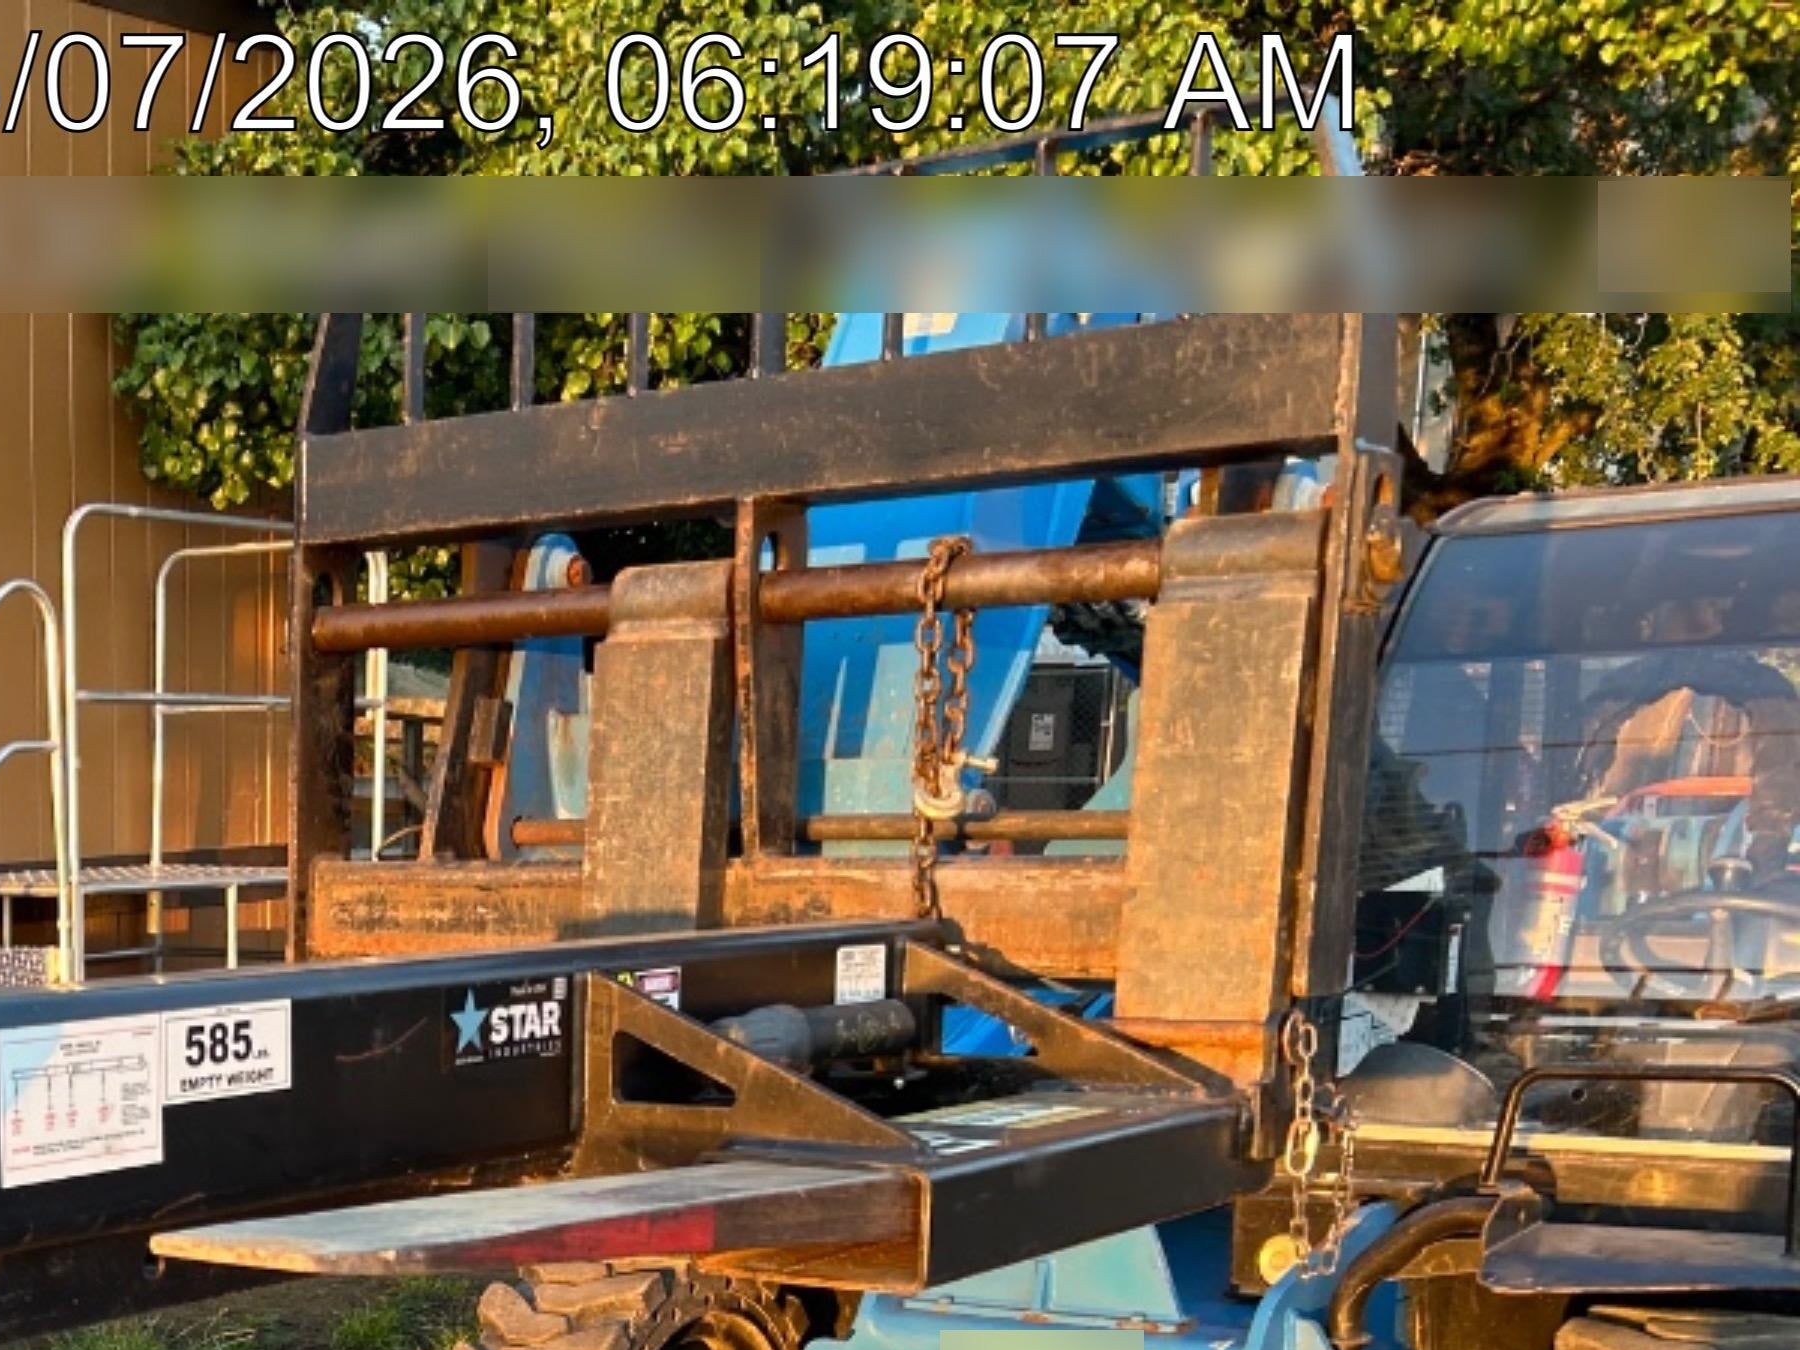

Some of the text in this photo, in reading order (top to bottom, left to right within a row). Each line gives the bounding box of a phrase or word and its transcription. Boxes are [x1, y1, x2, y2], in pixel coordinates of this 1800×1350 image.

[185, 1020, 253, 1068] 585
[489, 1001, 562, 1044] STAR
[180, 1066, 274, 1093] EMPTY WEIGHT
